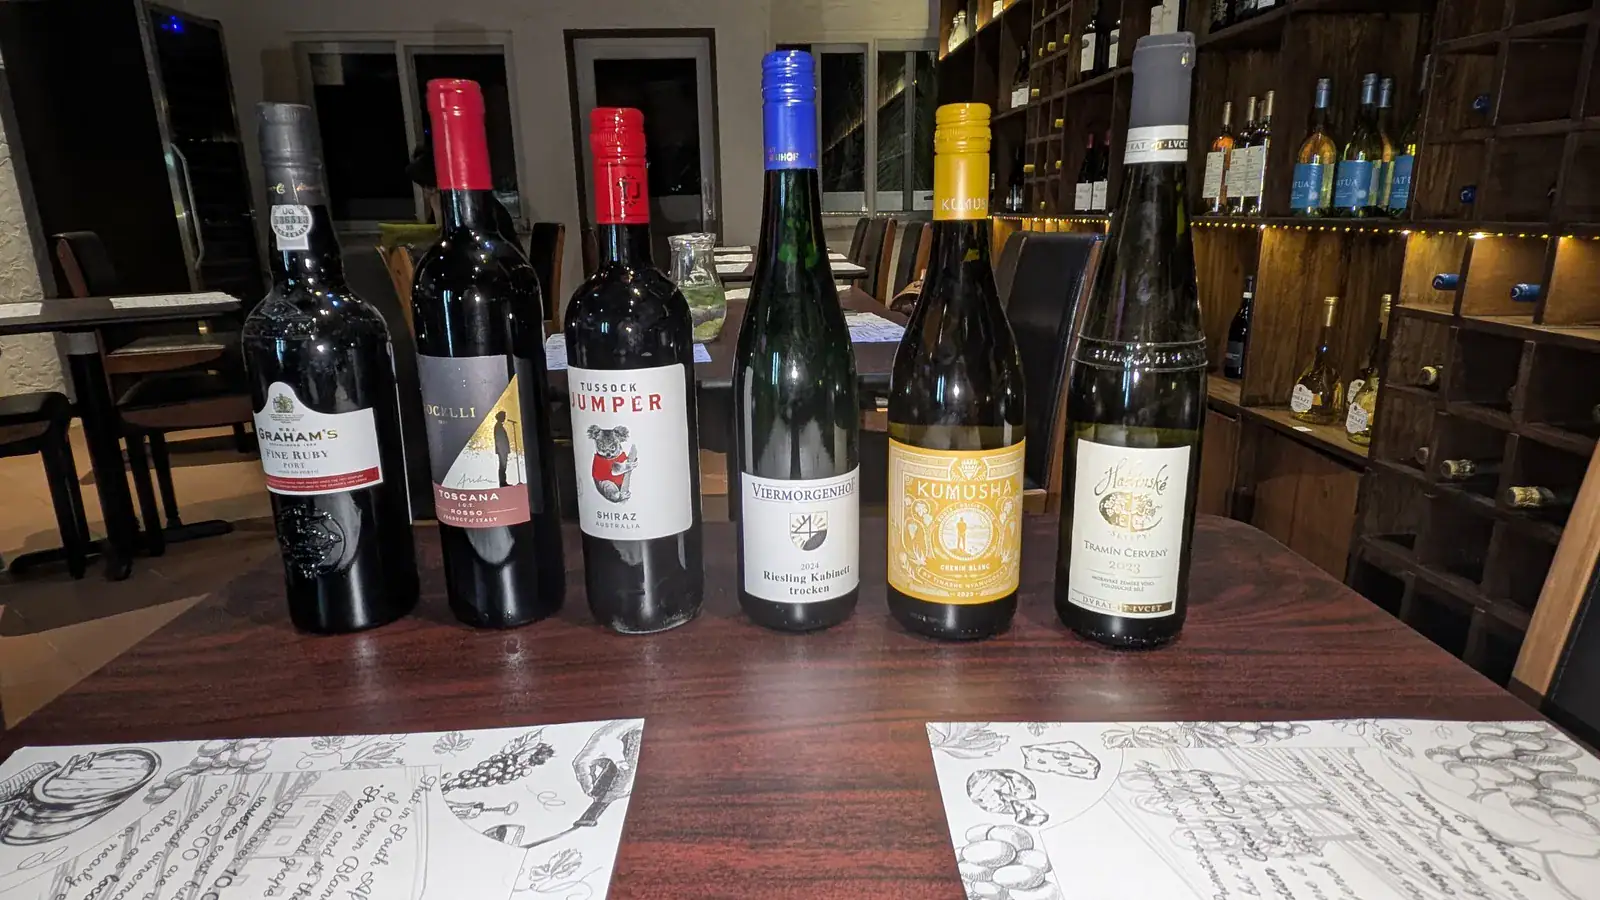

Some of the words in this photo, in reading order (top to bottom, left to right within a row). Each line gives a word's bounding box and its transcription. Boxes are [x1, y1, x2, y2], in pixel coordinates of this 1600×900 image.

[580, 382, 637, 393] TUSSOCK
[571, 392, 663, 413] JUMPER
[258, 427, 339, 442] GRAHAM'S
[266, 448, 289, 460] FINE
[293, 450, 329, 460] RUBY
[438, 489, 499, 501] TOSCANA
[752, 477, 856, 501] VIERMORGENHOF
[917, 480, 1012, 500] KUMUSHA
[595, 521, 641, 530] AUSTRALIA
[596, 511, 637, 521] SHIRAZ
[1083, 540, 1121, 556] TRAMÍN
[763, 571, 807, 584] Riesling
[811, 565, 850, 582] Kabinett
[800, 562, 820, 570] 2024
[789, 585, 830, 595] trocken
[408, 774, 437, 805] That
[165, 784, 229, 849] commercial
[224, 796, 267, 840] varieties
[398, 806, 414, 820] in
[118, 826, 135, 840] or
[140, 809, 177, 844] others
[182, 790, 249, 861] 150-200
[296, 804, 336, 856] planted
[352, 806, 392, 852] Chenin
[233, 836, 258, 864] over
[321, 831, 343, 859] and
[370, 823, 408, 866] South
[65, 843, 118, 888] nearly
[115, 847, 139, 870] are
[194, 843, 224, 877] exist
[155, 865, 178, 888] are
[264, 856, 296, 898] grape
